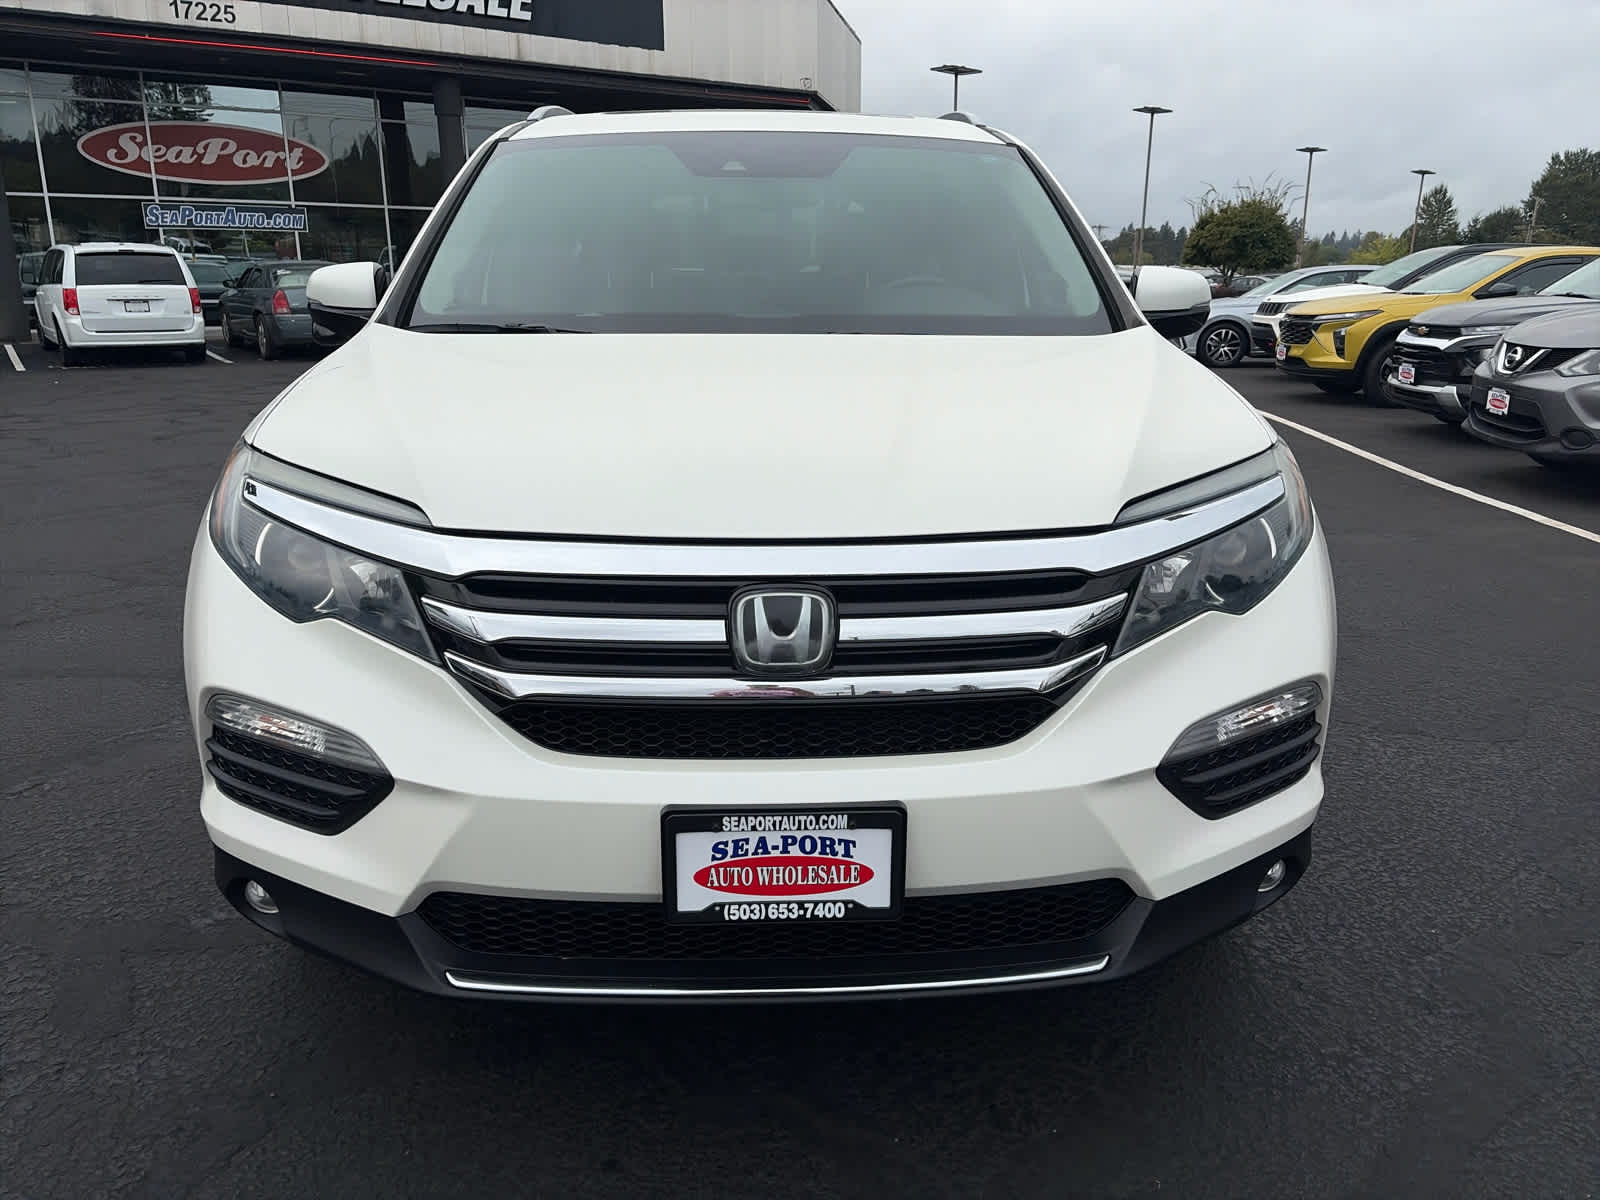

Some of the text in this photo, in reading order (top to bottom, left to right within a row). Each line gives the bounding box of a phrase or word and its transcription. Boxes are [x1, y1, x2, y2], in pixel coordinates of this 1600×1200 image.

[169, 0, 236, 24] 17225
[106, 132, 304, 170] SeaPort
[722, 814, 848, 832] SEAPORTAUTO.COM
[711, 834, 857, 862] SEA-PORT
[707, 864, 861, 887] AUTO WHOLESALE
